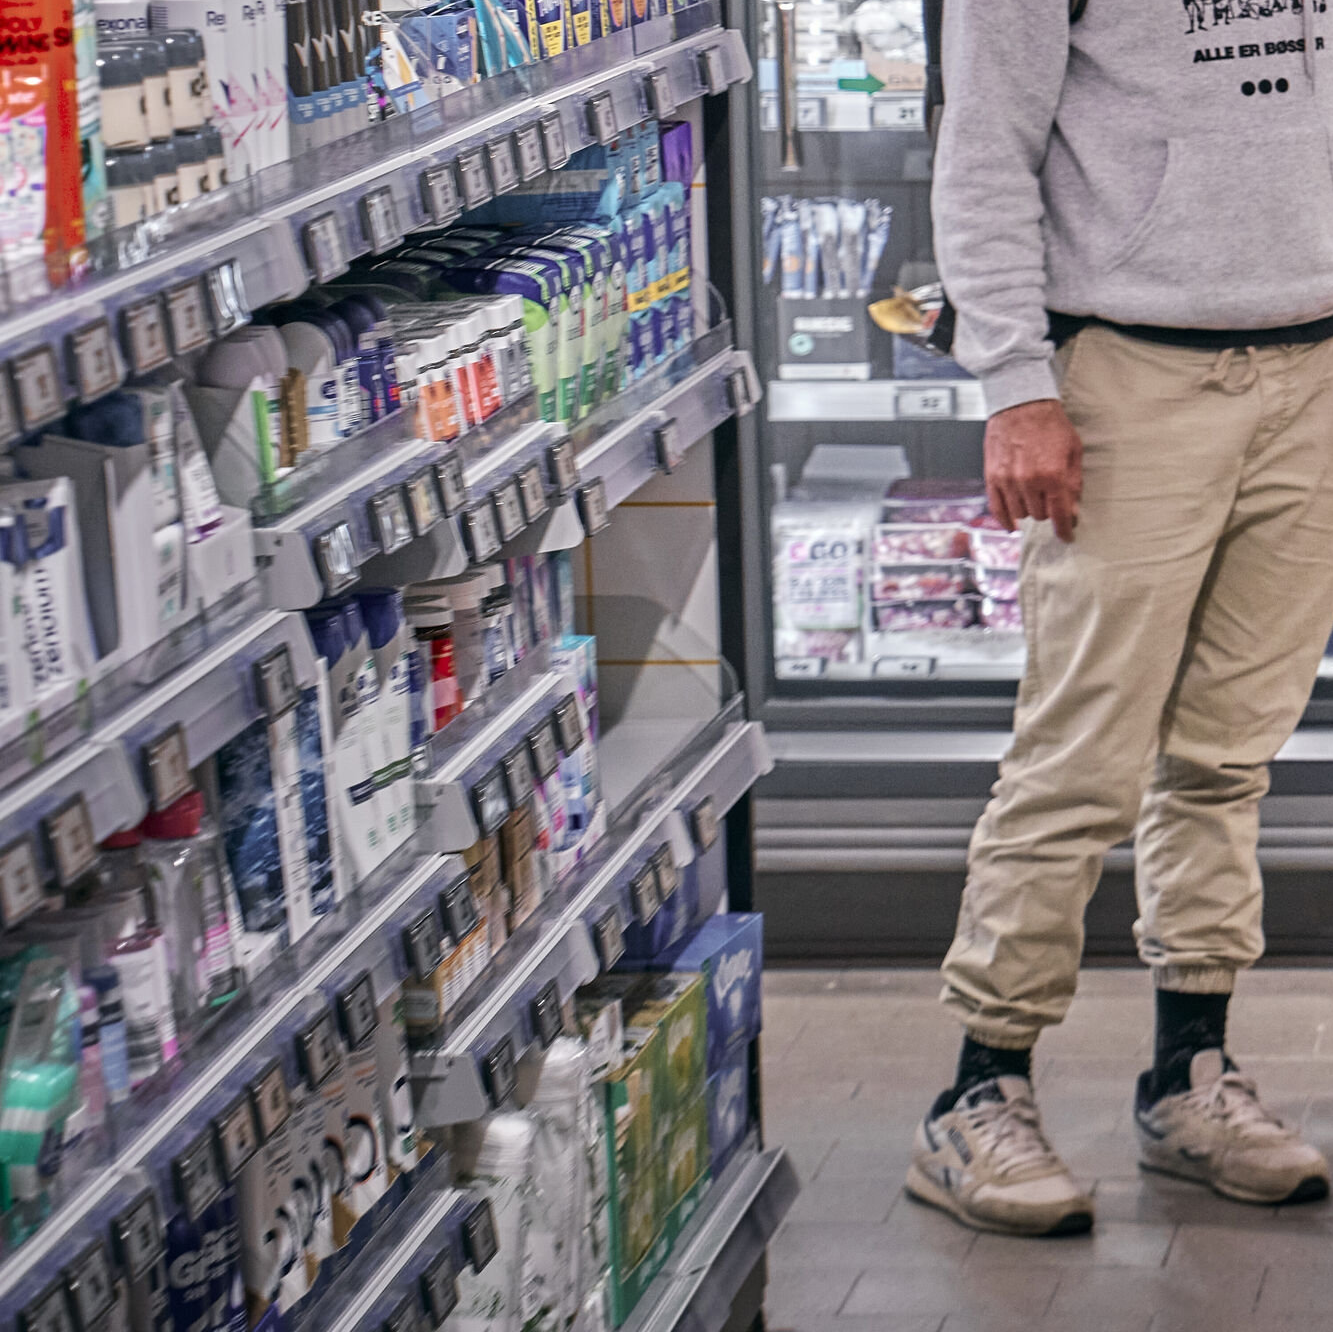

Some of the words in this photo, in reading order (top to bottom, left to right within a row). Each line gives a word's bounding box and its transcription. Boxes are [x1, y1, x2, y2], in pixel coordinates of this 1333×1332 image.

[97, 16, 147, 32] exona
[1193, 45, 1236, 64] ALLE
[1238, 43, 1262, 59] ER
[1264, 36, 1325, 57] BØSSR
